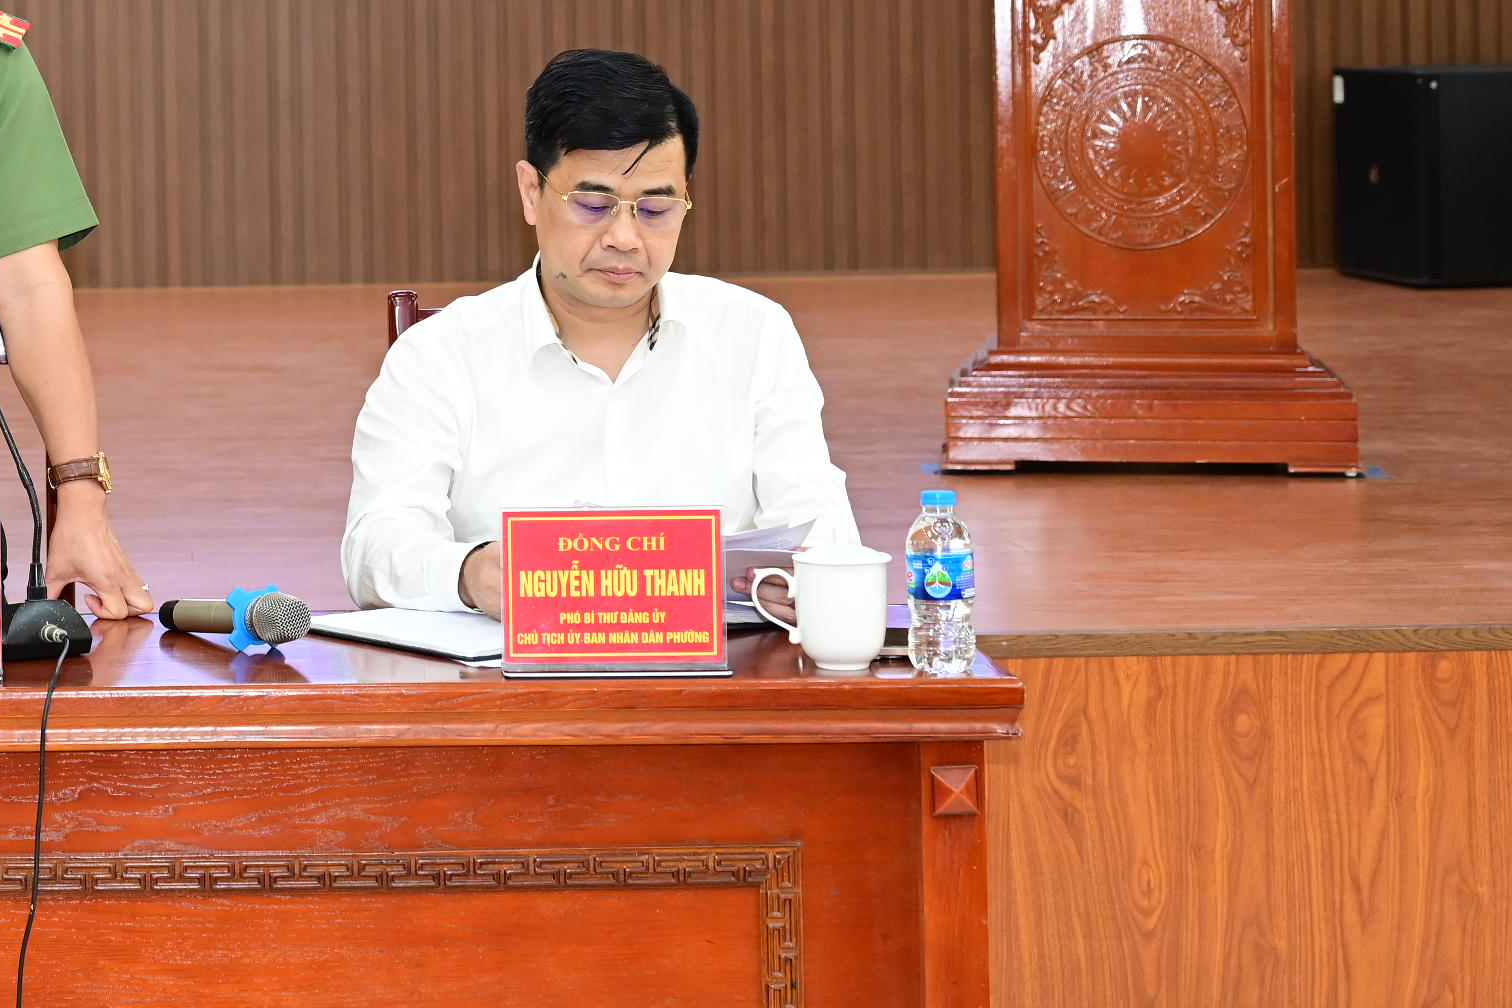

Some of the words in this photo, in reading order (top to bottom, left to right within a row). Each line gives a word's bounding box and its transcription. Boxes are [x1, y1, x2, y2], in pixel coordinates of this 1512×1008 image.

[627, 533, 664, 550] CHÍ
[519, 559, 595, 598] NGUYỄN
[600, 563, 638, 597] HỮU
[642, 568, 706, 597] THANH
[560, 611, 581, 624] PHÓ
[584, 611, 594, 623] BÍ
[597, 611, 618, 623] THƯ
[620, 609, 649, 623] ĐẢNG
[652, 609, 665, 623] ỦY
[517, 630, 538, 644] CHỦ
[541, 633, 564, 646] TỊCH
[568, 630, 580, 644] ỦY
[584, 633, 605, 644] BAN
[609, 631, 638, 643] NHÂN
[642, 630, 663, 643] DÂN
[666, 629, 709, 643] PHƯỜNG
